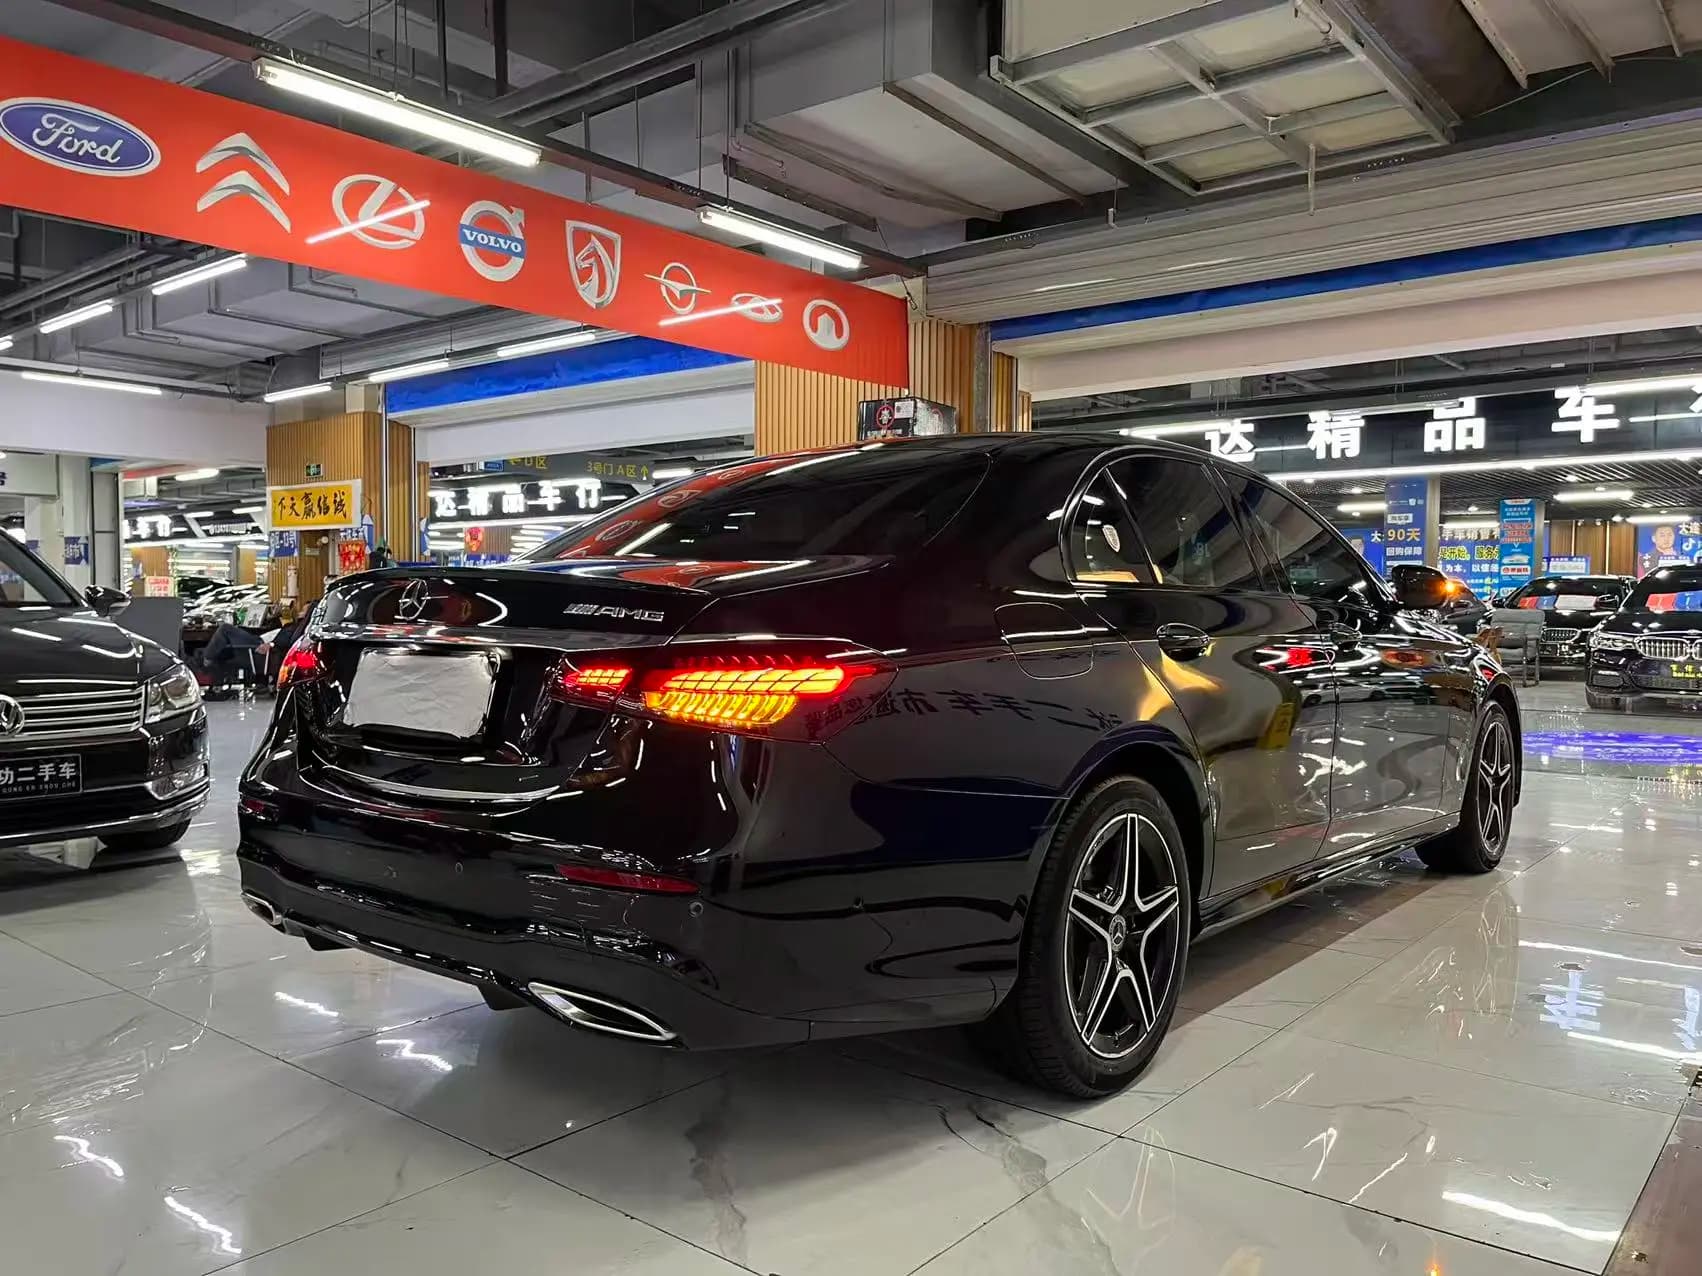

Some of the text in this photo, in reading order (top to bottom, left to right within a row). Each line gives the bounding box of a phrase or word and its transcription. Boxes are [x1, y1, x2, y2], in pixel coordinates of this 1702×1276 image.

[34, 112, 123, 165] Ford
[463, 228, 522, 254] VOLVO
[1205, 388, 1702, 463] 达精品车
[1387, 528, 1420, 541] 90天
[597, 603, 664, 622] AMG
